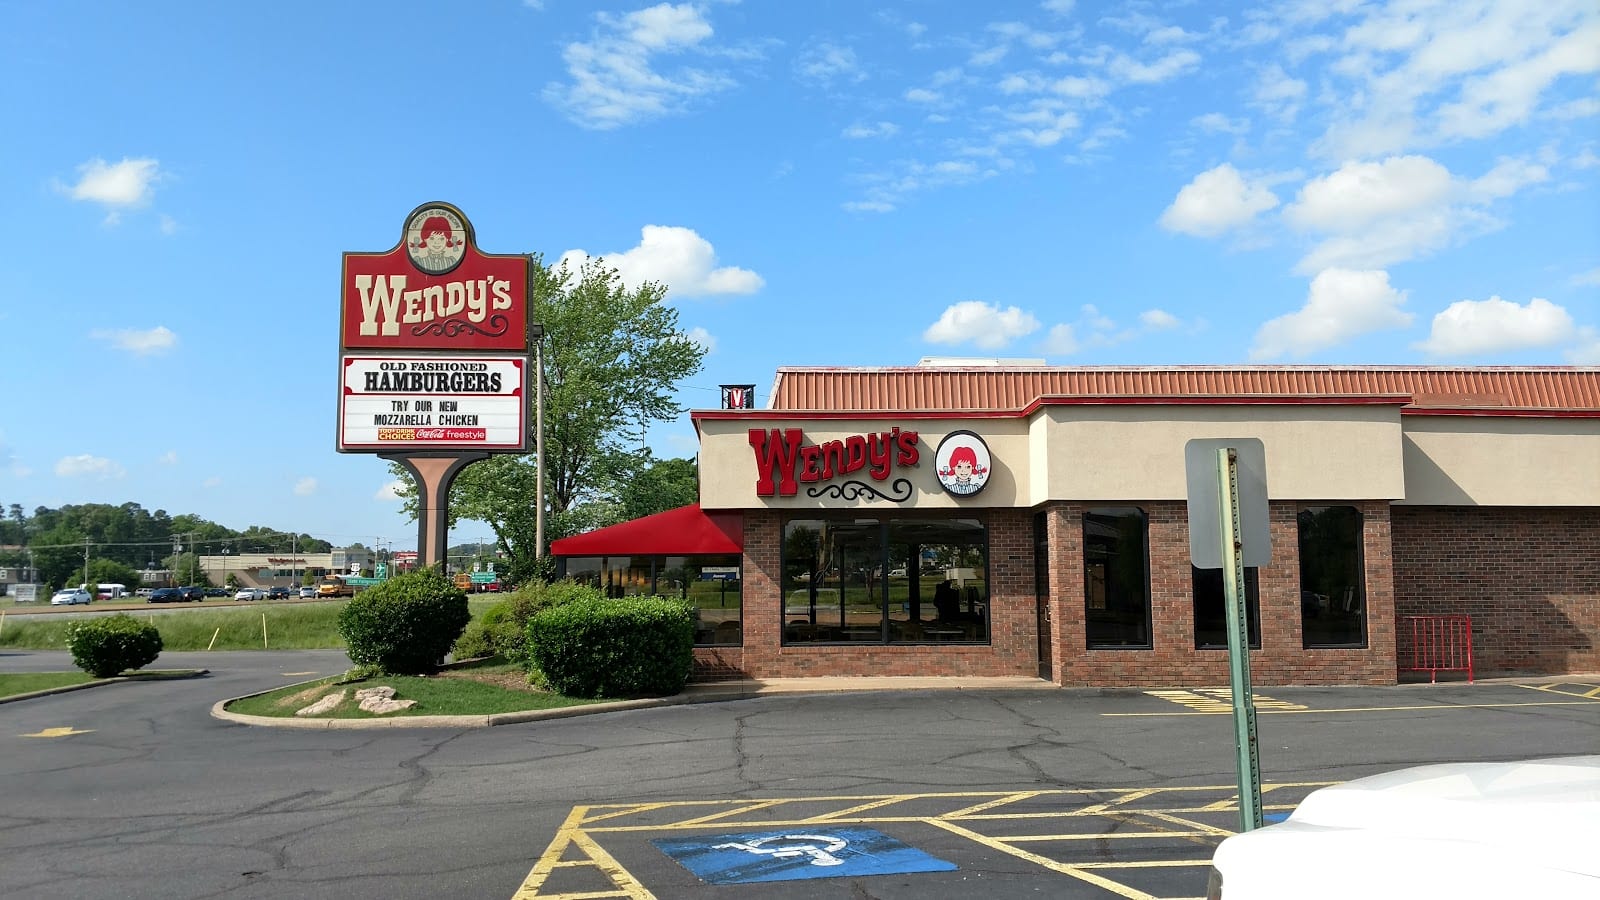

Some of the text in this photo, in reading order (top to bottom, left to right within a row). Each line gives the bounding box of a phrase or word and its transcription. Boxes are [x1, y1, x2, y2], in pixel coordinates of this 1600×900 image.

[379, 362, 488, 372] OLD FASHIONED
[363, 371, 502, 393] HAMBURGERS
[391, 400, 458, 412] TRY OUR NEW
[374, 414, 478, 426] MOZZARELLA CHICKEN
[446, 430, 485, 440] freestyle
